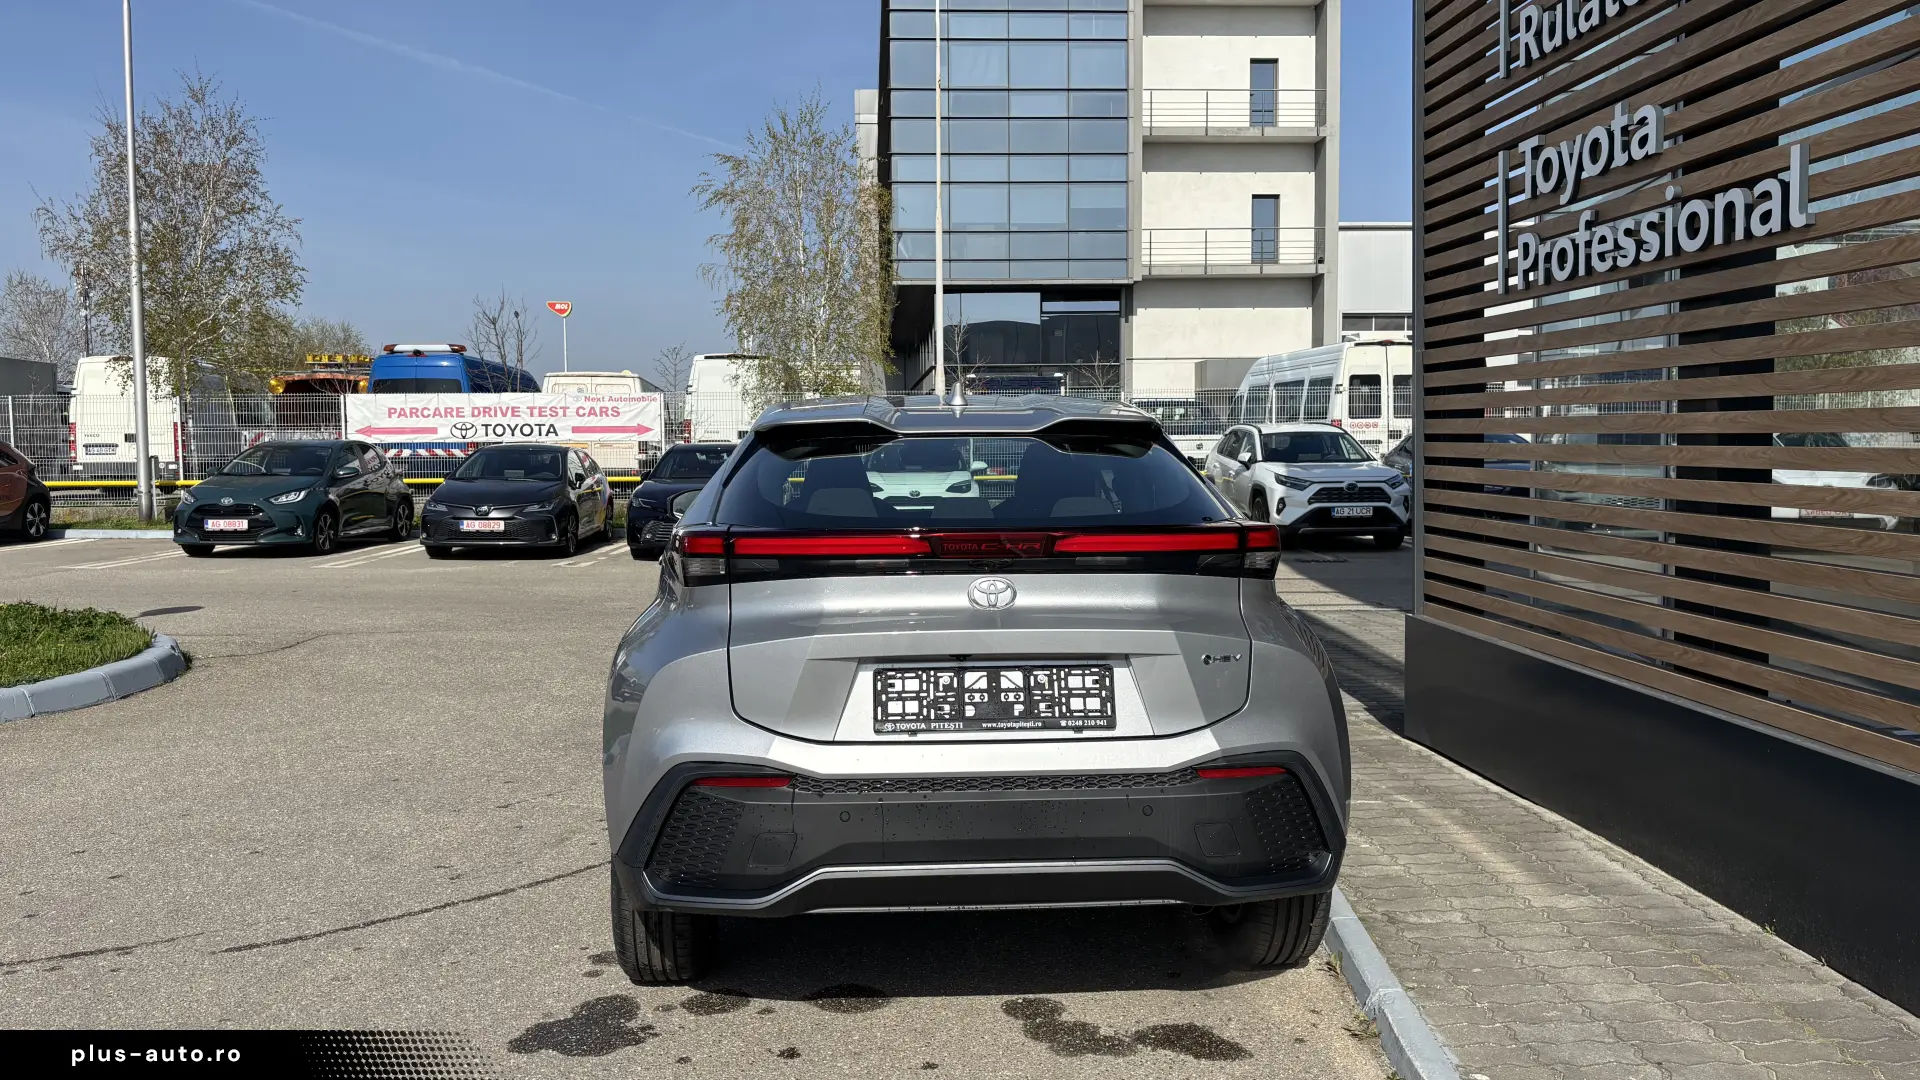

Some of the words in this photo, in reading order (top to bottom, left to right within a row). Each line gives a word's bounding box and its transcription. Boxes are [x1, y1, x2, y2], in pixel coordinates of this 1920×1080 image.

[1519, 0, 1641, 68] Rula
[1518, 101, 1664, 206] Toyota
[1517, 142, 1816, 291] Professional
[584, 395, 605, 403] Next
[608, 395, 658, 403] Automobile
[387, 406, 466, 419] PARCARE
[471, 406, 521, 418] DRIVE
[526, 406, 569, 418] TEST
[575, 406, 621, 418] CARS
[481, 423, 559, 437] TOYOTA
[1335, 507, 1345, 515] AG
[1347, 507, 1354, 515] 21
[211, 520, 221, 528] AG
[223, 520, 244, 528] 08831
[466, 521, 476, 529] AG
[478, 521, 501, 529] 08829
[943, 543, 978, 551] TOYOTA
[1212, 654, 1243, 663] HEV
[1067, 719, 1083, 727] 0248
